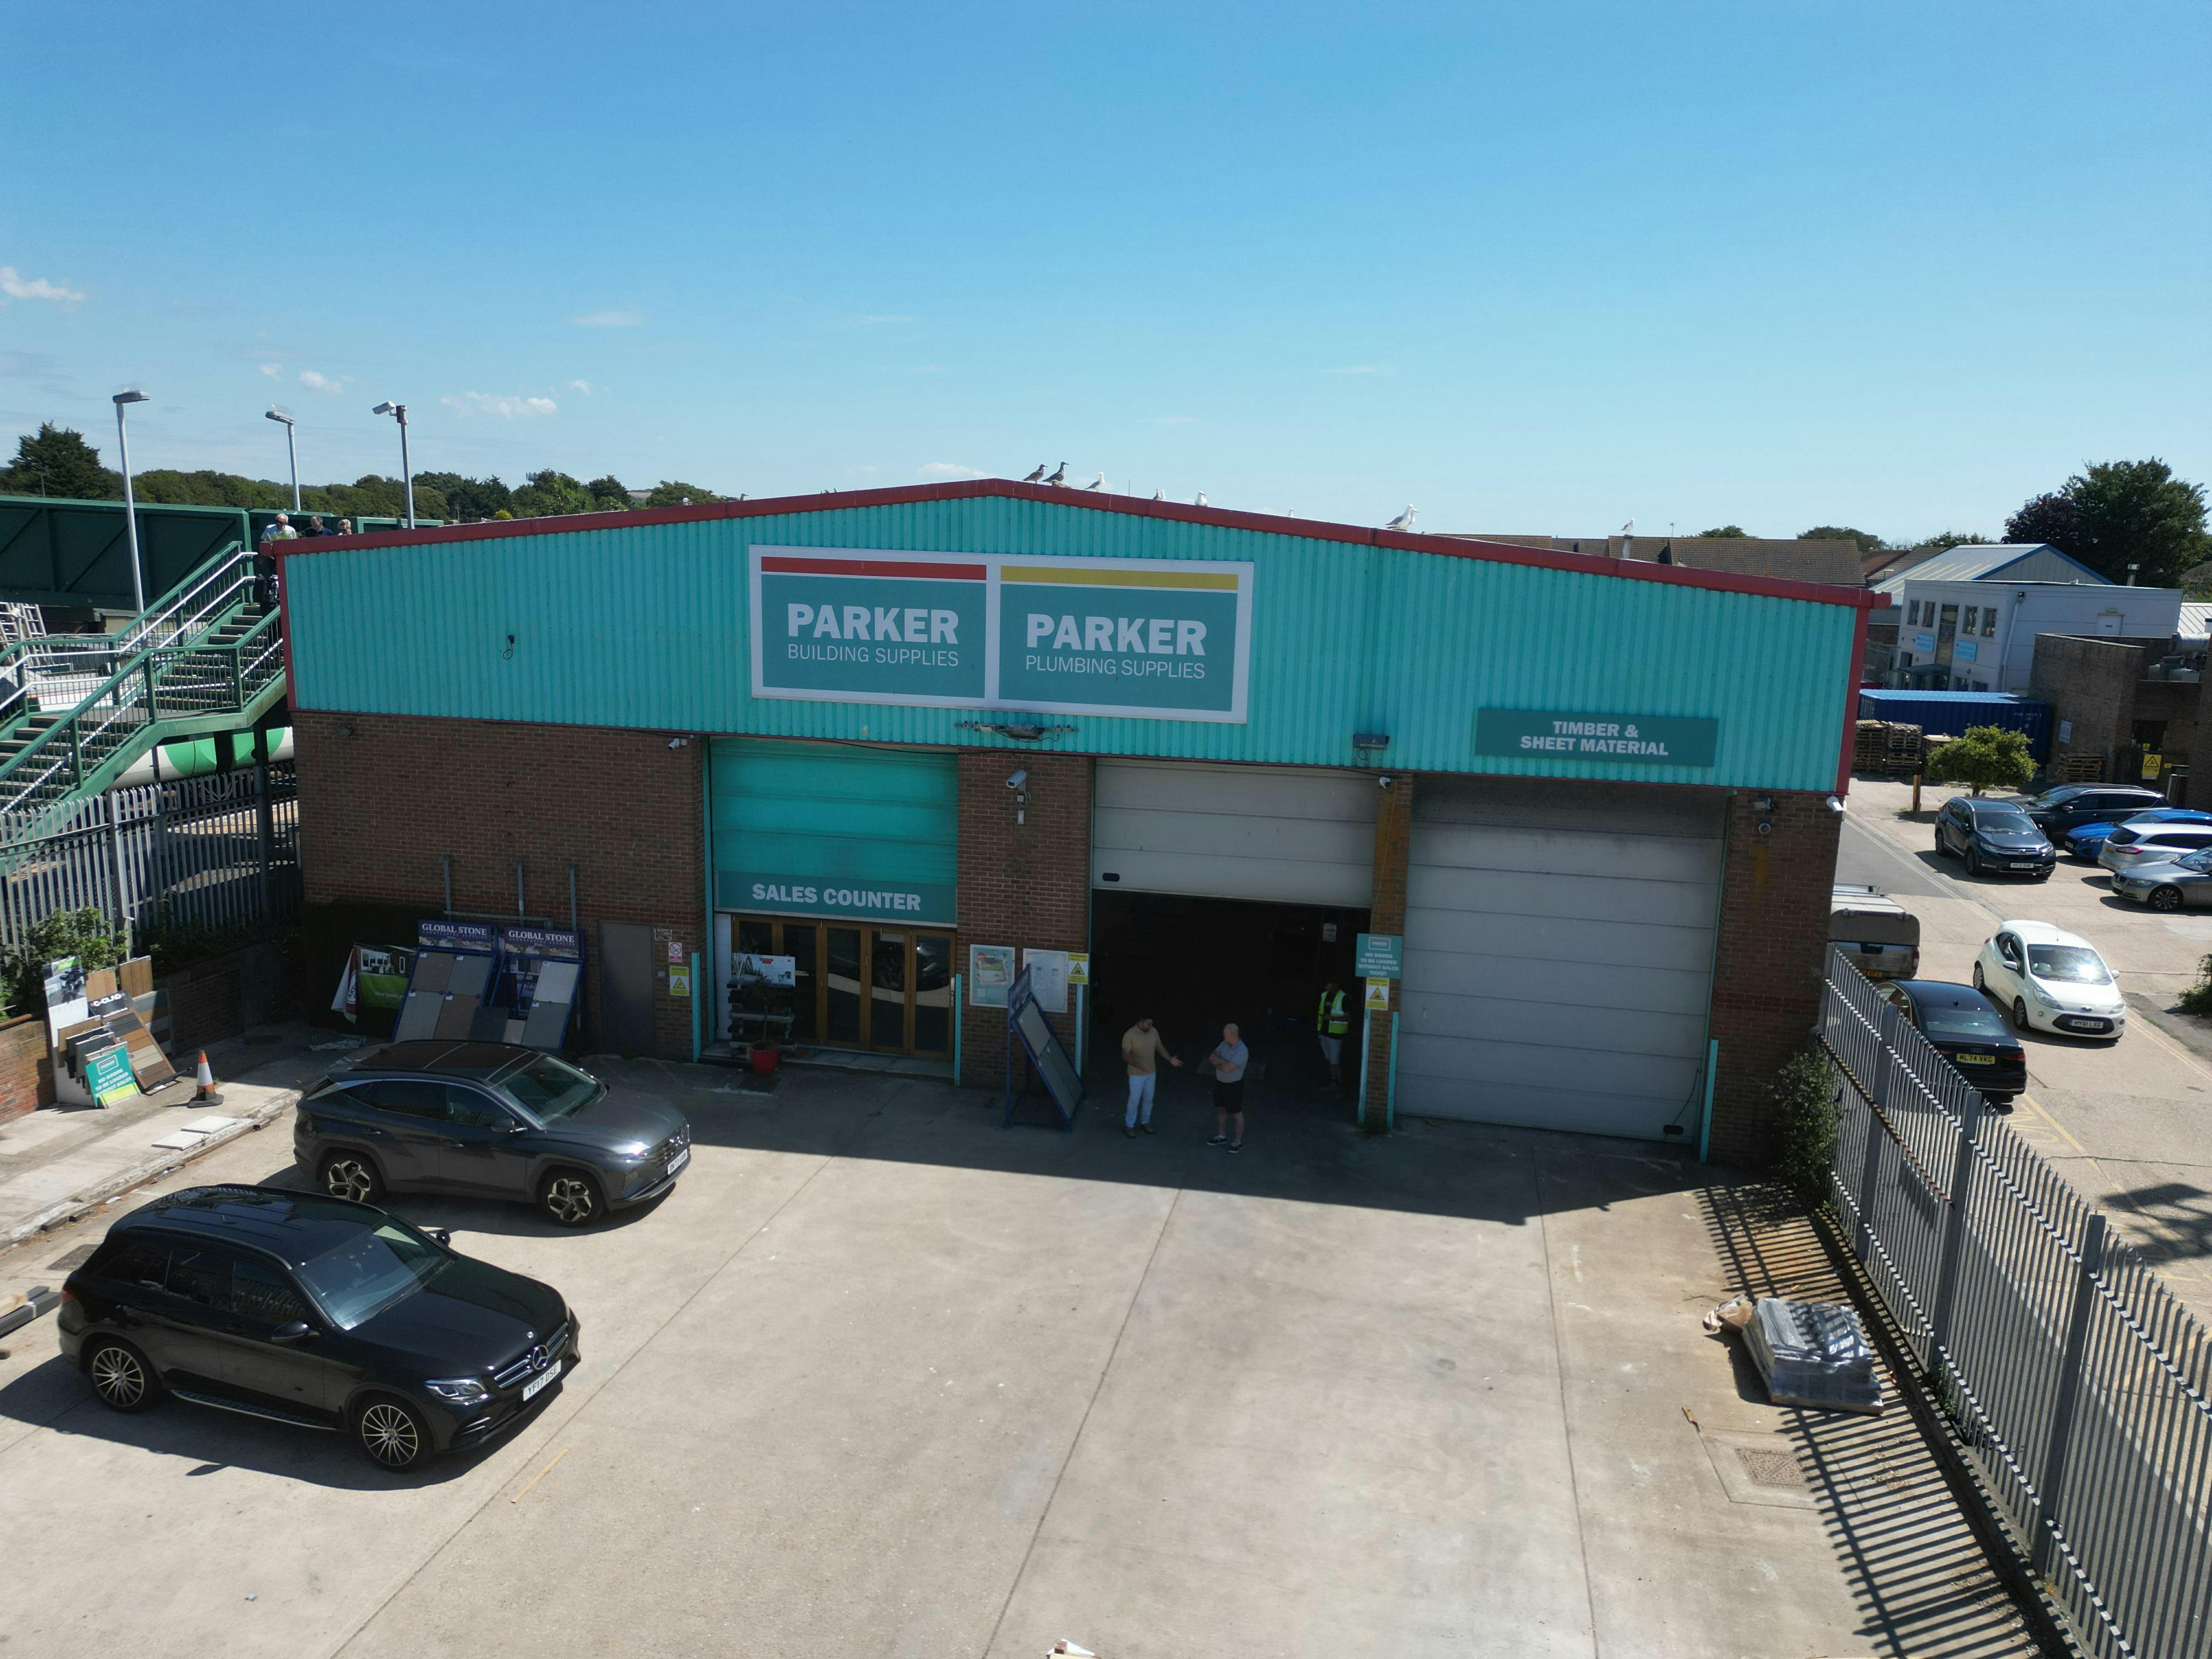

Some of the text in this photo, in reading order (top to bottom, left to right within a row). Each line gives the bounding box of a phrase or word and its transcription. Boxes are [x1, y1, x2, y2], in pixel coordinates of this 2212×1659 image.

[787, 603, 959, 644] PARKER
[1027, 613, 1207, 656] PARKER
[788, 644, 959, 668] BUILDING SUPPLIES
[1026, 655, 1206, 680] PLUMBING SUPPLIES
[1553, 720, 1639, 738] TIMBER &
[1520, 735, 1669, 756] SHEET MATERIAL
[752, 883, 921, 911] SALES COUNTER
[422, 923, 488, 935] GLOBAL STONE
[509, 930, 575, 943] GLOBAL STONE
[109, 1072, 129, 1084] LOADED
[528, 1377, 544, 1395] YF17
